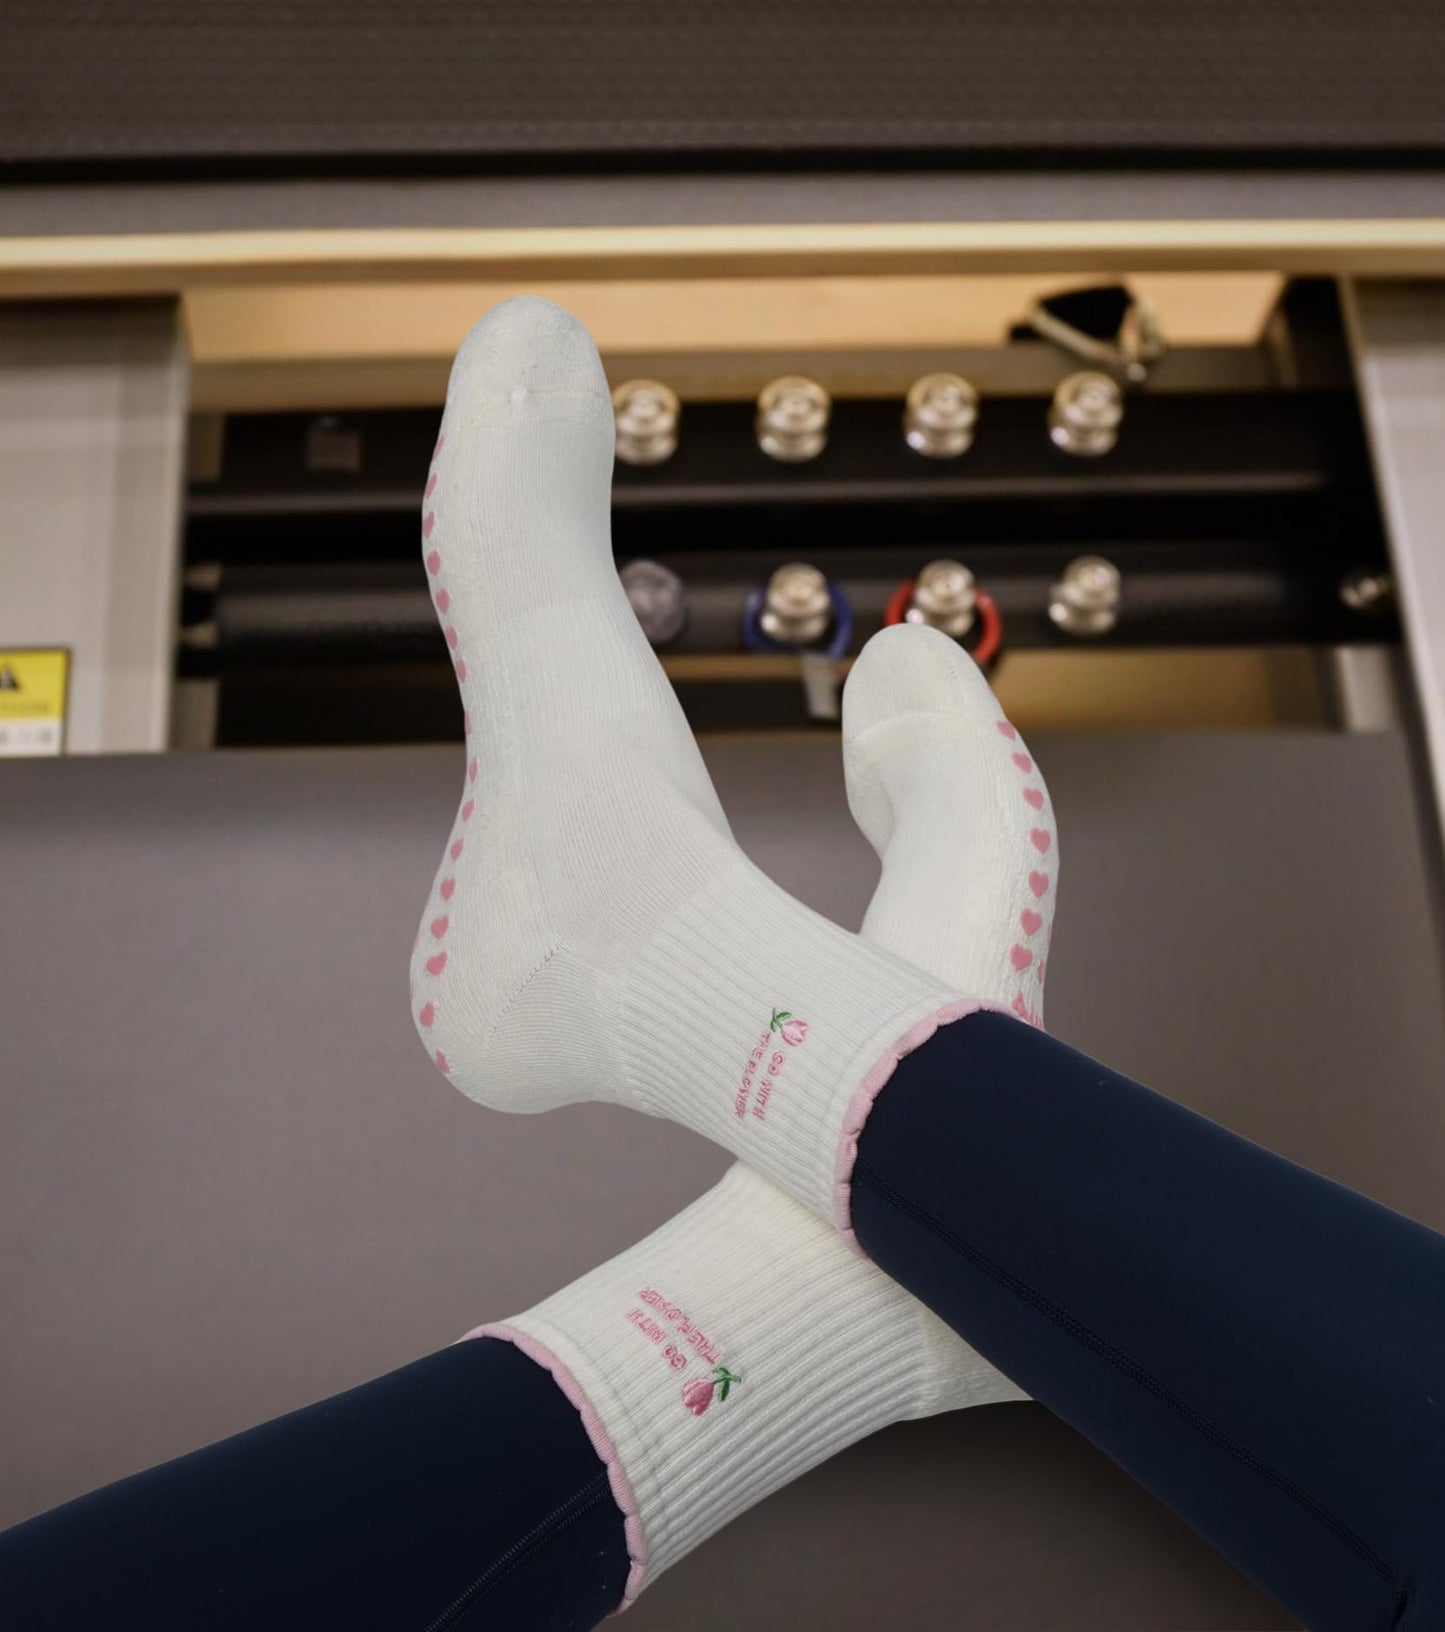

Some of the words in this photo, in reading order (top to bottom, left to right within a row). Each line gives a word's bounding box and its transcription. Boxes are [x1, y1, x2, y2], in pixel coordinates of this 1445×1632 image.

[752, 1031, 770, 1060] THE
[753, 1079, 772, 1121] WITH
[626, 1308, 665, 1344] WITH
[661, 1343, 688, 1370] GO
[687, 1331, 721, 1365] THE
